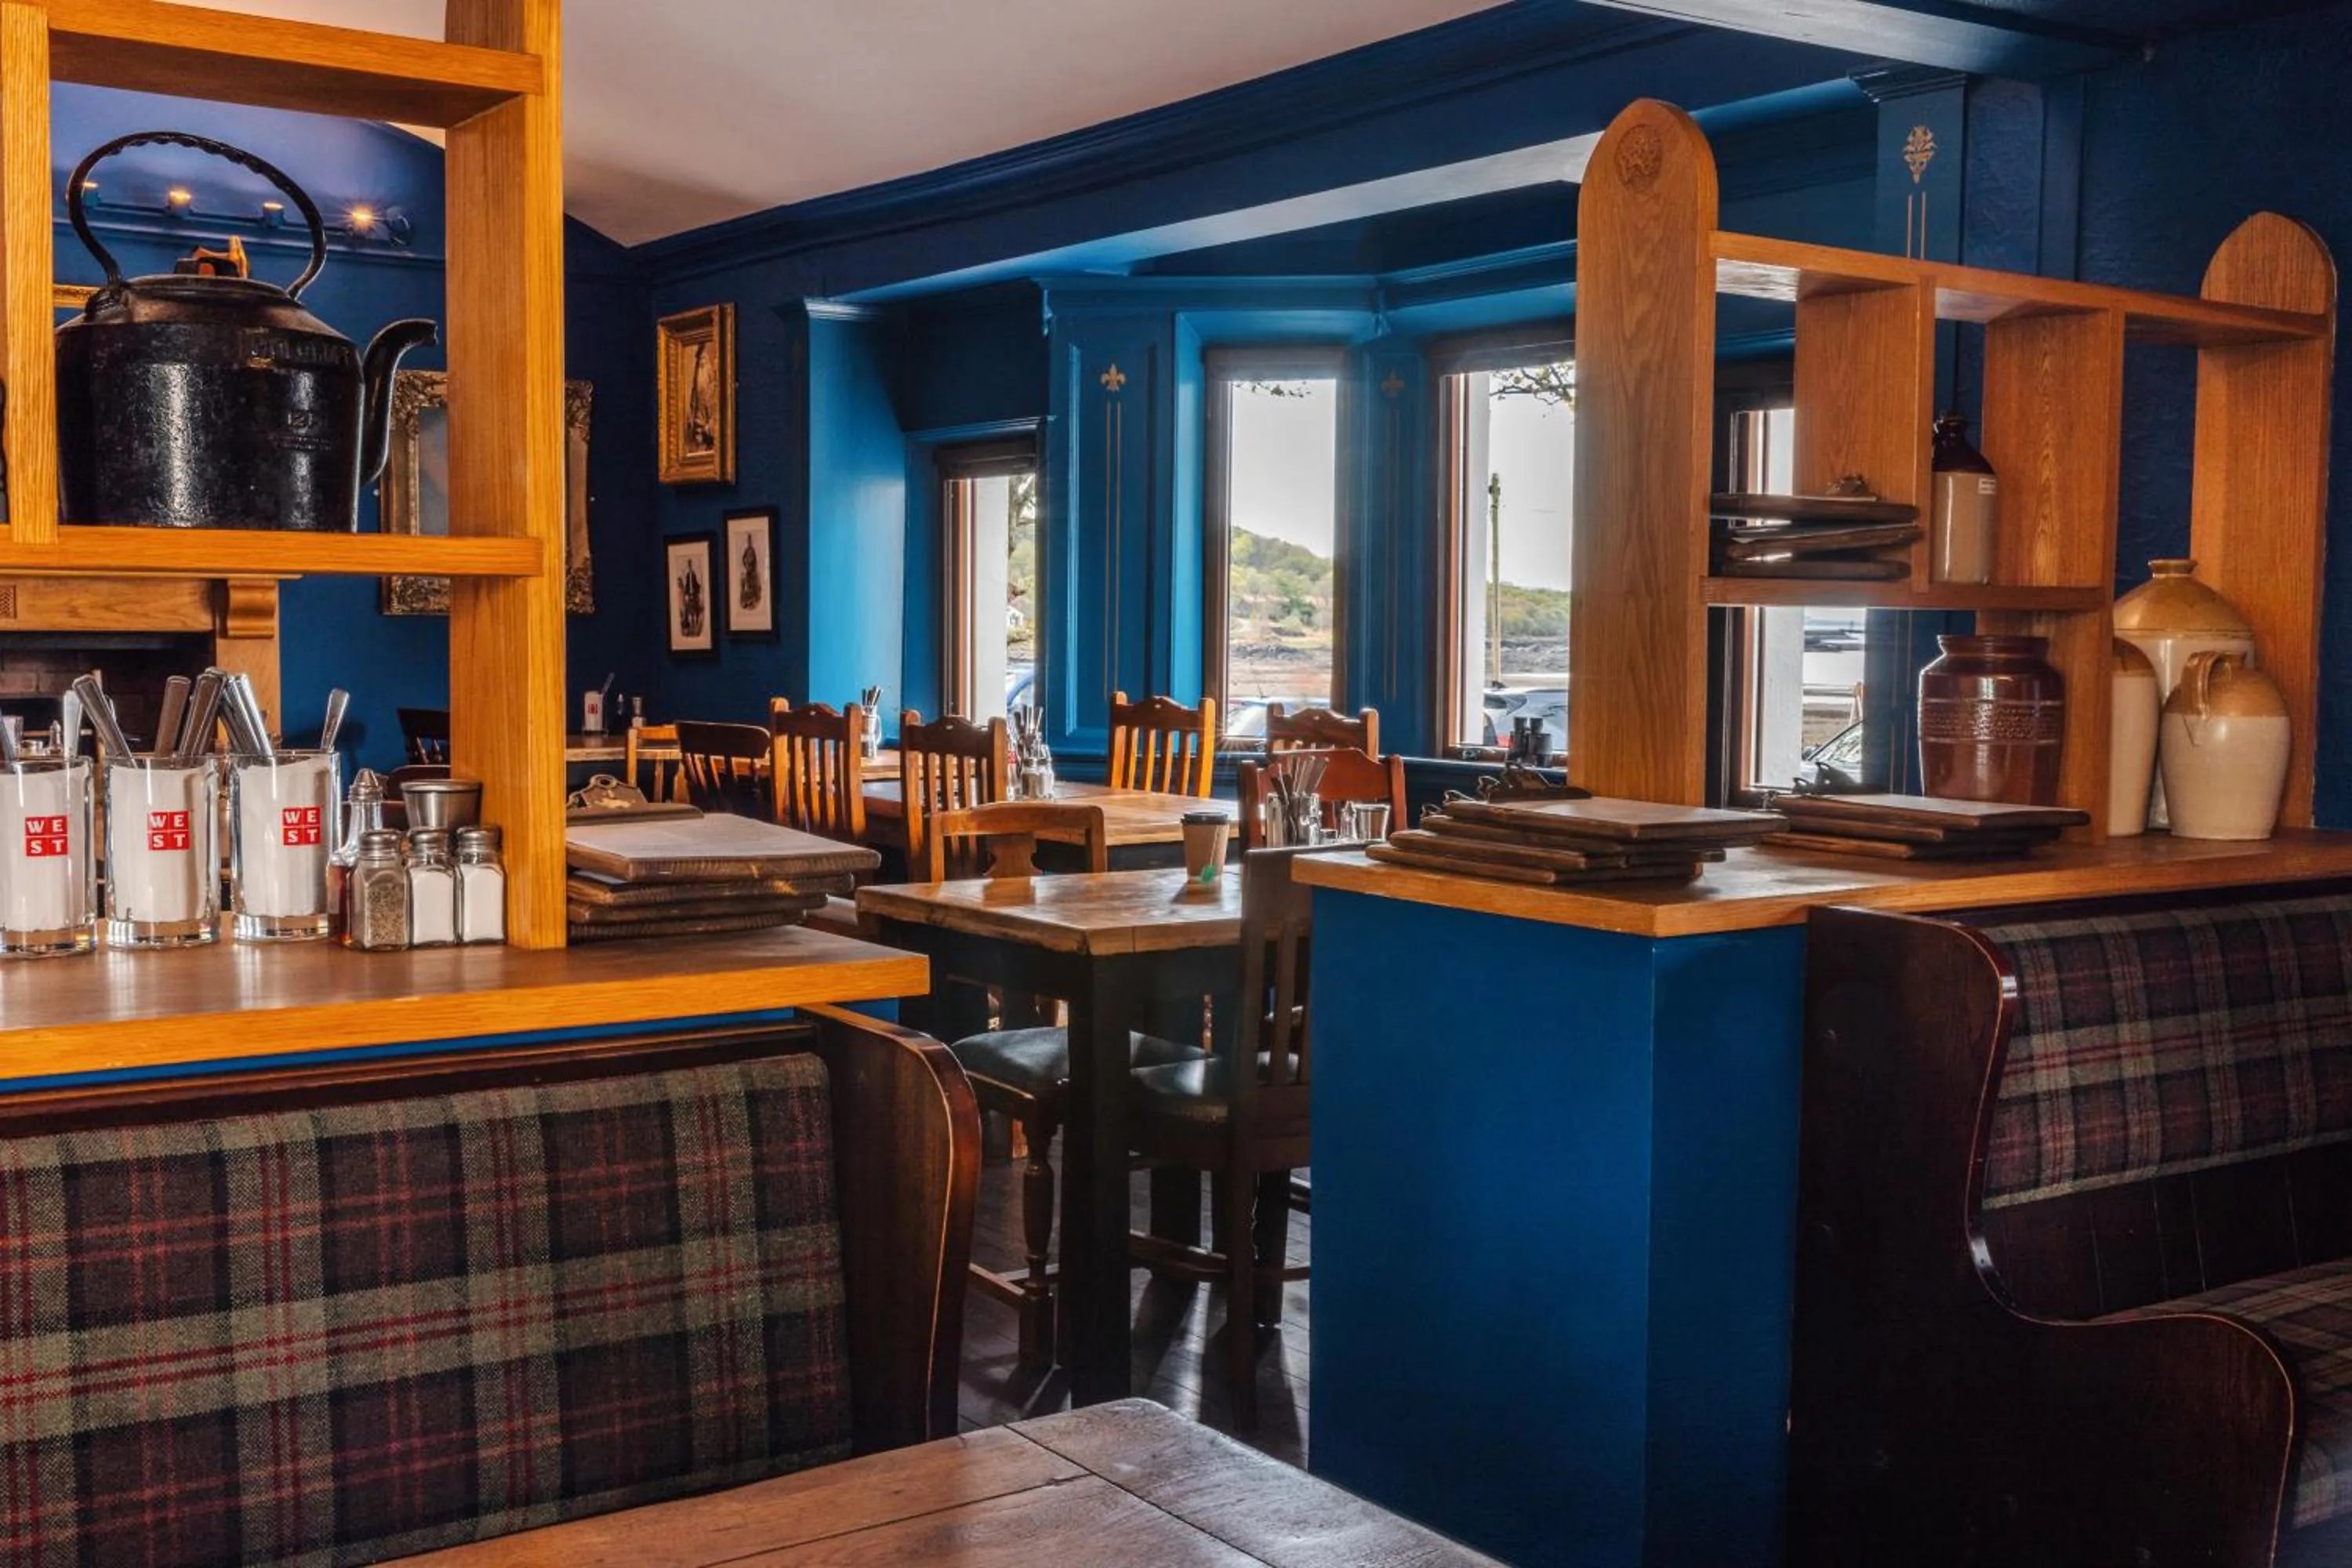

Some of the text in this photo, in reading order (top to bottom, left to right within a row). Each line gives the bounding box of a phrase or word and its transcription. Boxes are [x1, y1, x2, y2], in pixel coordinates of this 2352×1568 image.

[150, 815, 185, 828] WE
[284, 810, 318, 824] WE
[27, 819, 64, 833] WE
[153, 833, 186, 848] ST
[288, 829, 318, 843] ST
[31, 839, 65, 854] ST
